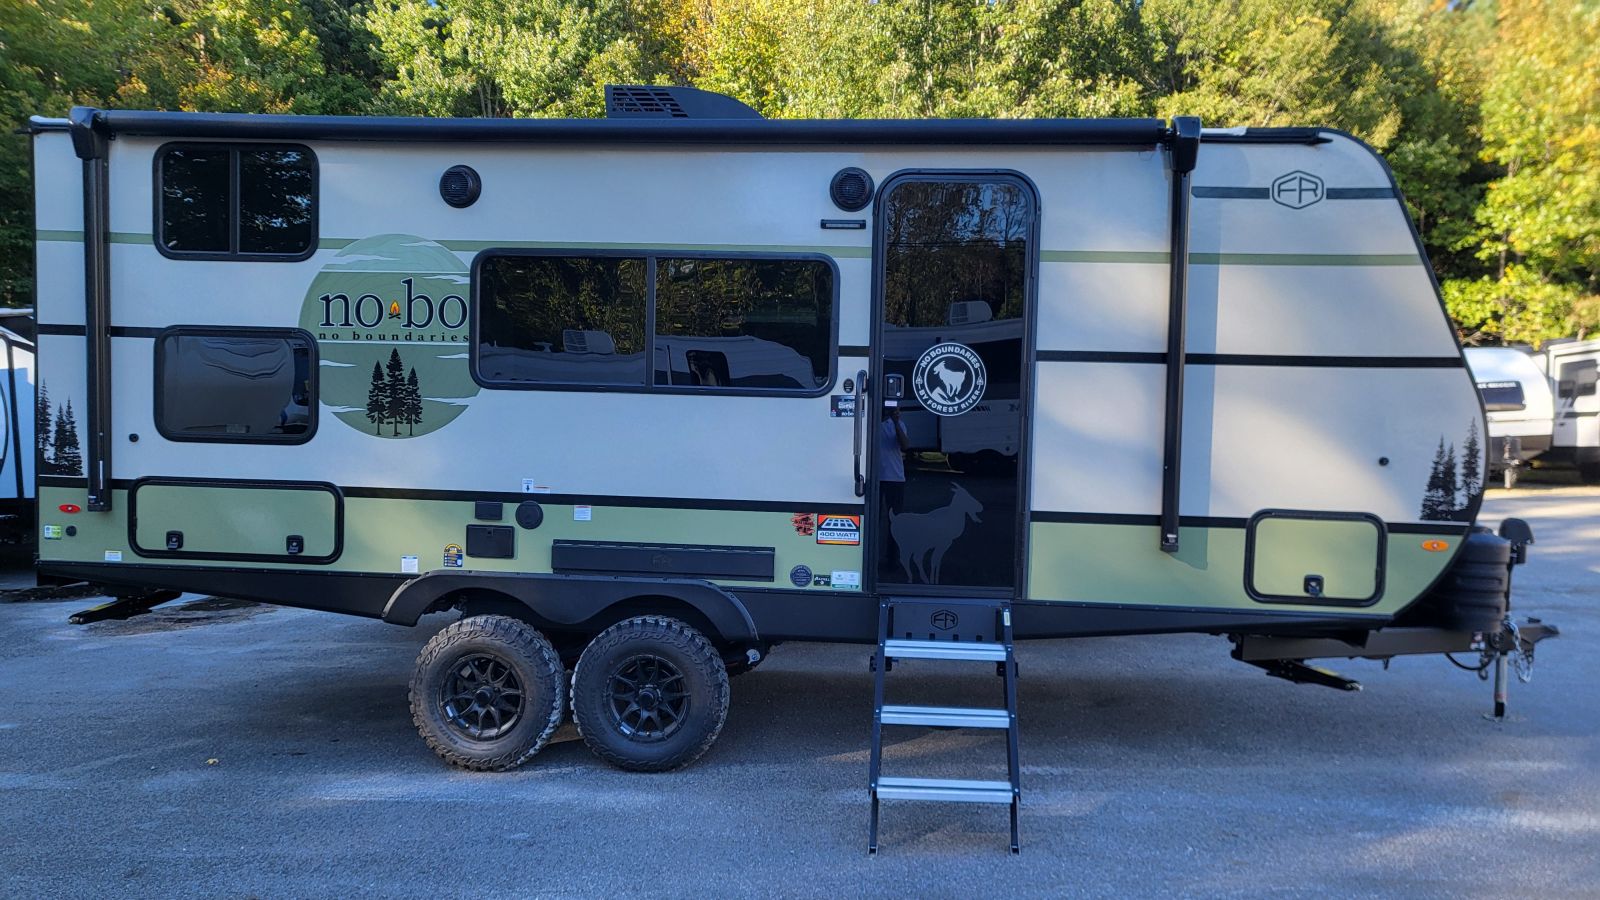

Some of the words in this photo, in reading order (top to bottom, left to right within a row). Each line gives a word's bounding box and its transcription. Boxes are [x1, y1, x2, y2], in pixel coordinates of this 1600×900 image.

[319, 332, 339, 340] no
[353, 331, 469, 341] boundaries
[920, 356, 931, 368] NO
[931, 346, 980, 368] BOUNDARIES
[919, 389, 928, 400] BY
[927, 400, 958, 412] FOREST
[961, 390, 980, 408] RIVER
